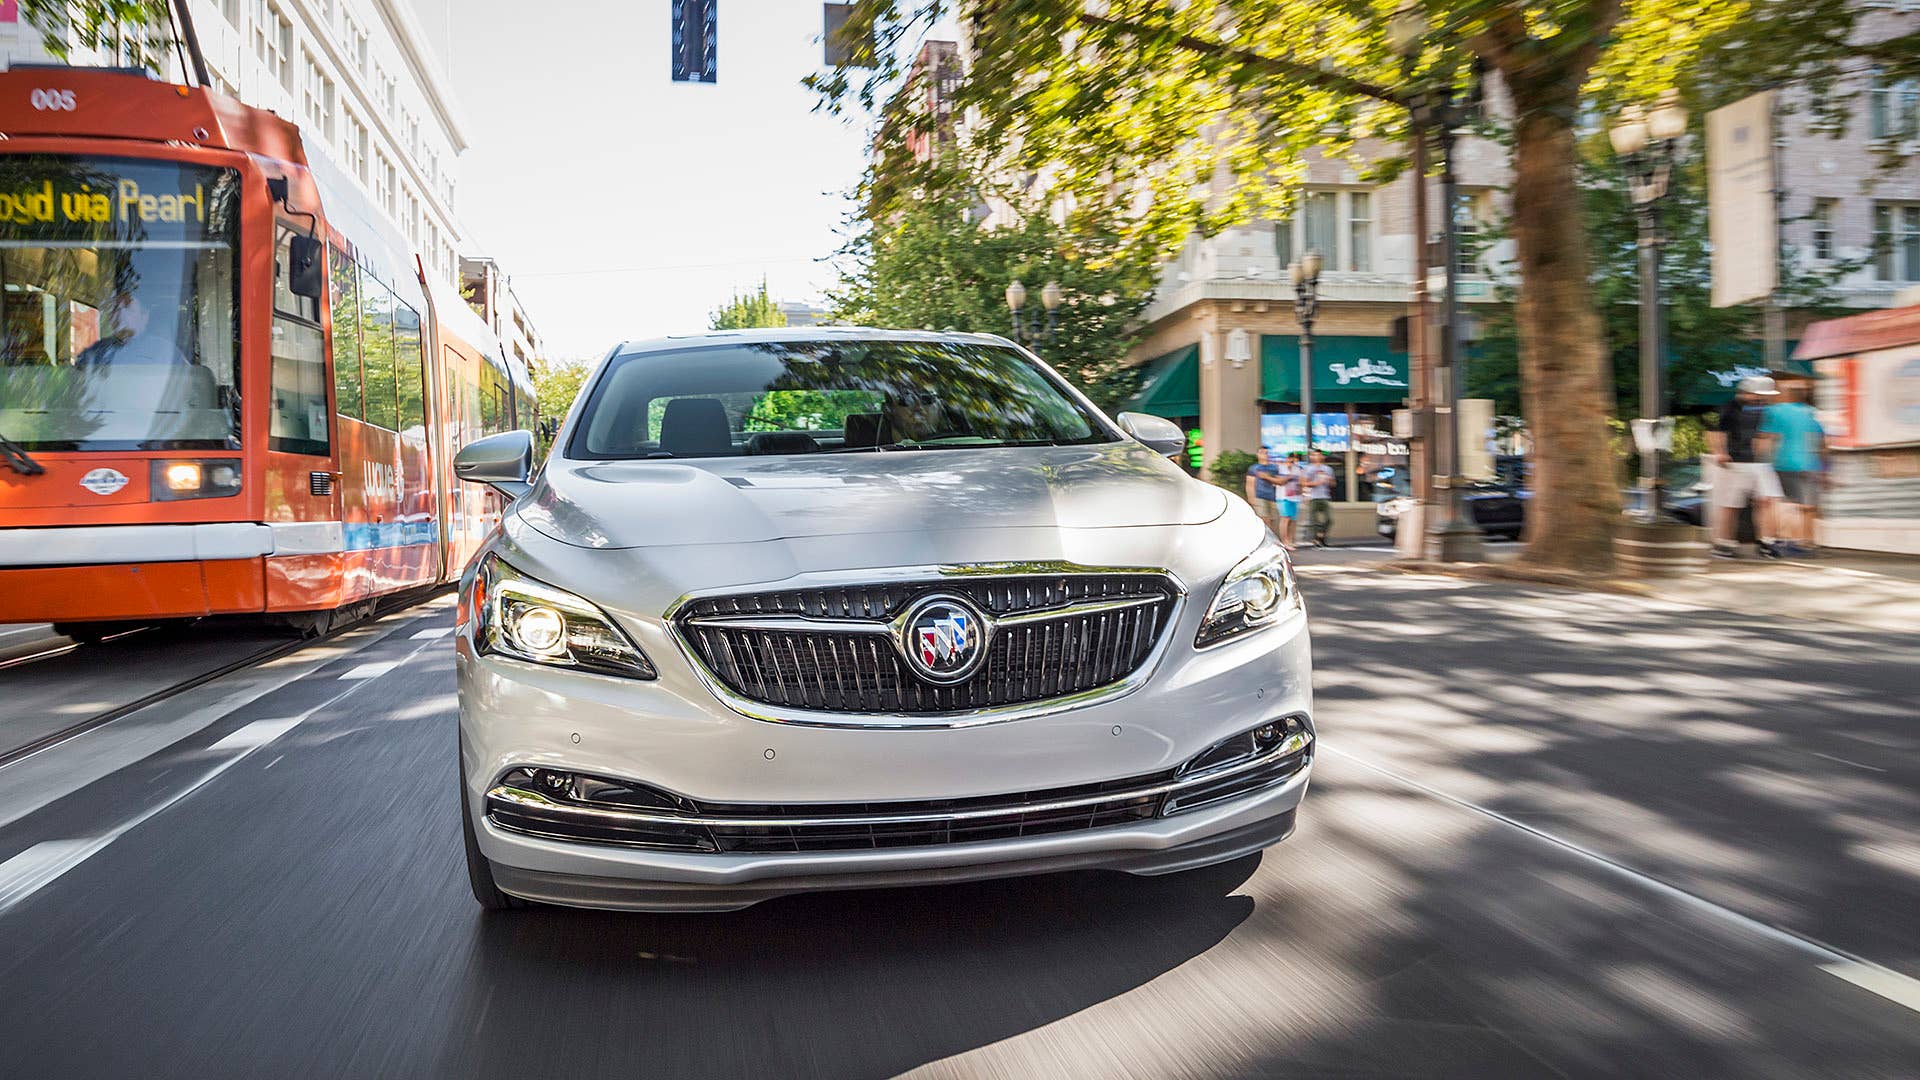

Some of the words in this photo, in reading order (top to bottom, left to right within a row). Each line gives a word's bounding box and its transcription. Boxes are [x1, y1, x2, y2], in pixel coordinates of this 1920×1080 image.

[31, 88, 77, 111] 005
[61, 183, 110, 223] via
[119, 178, 204, 222] Pearl
